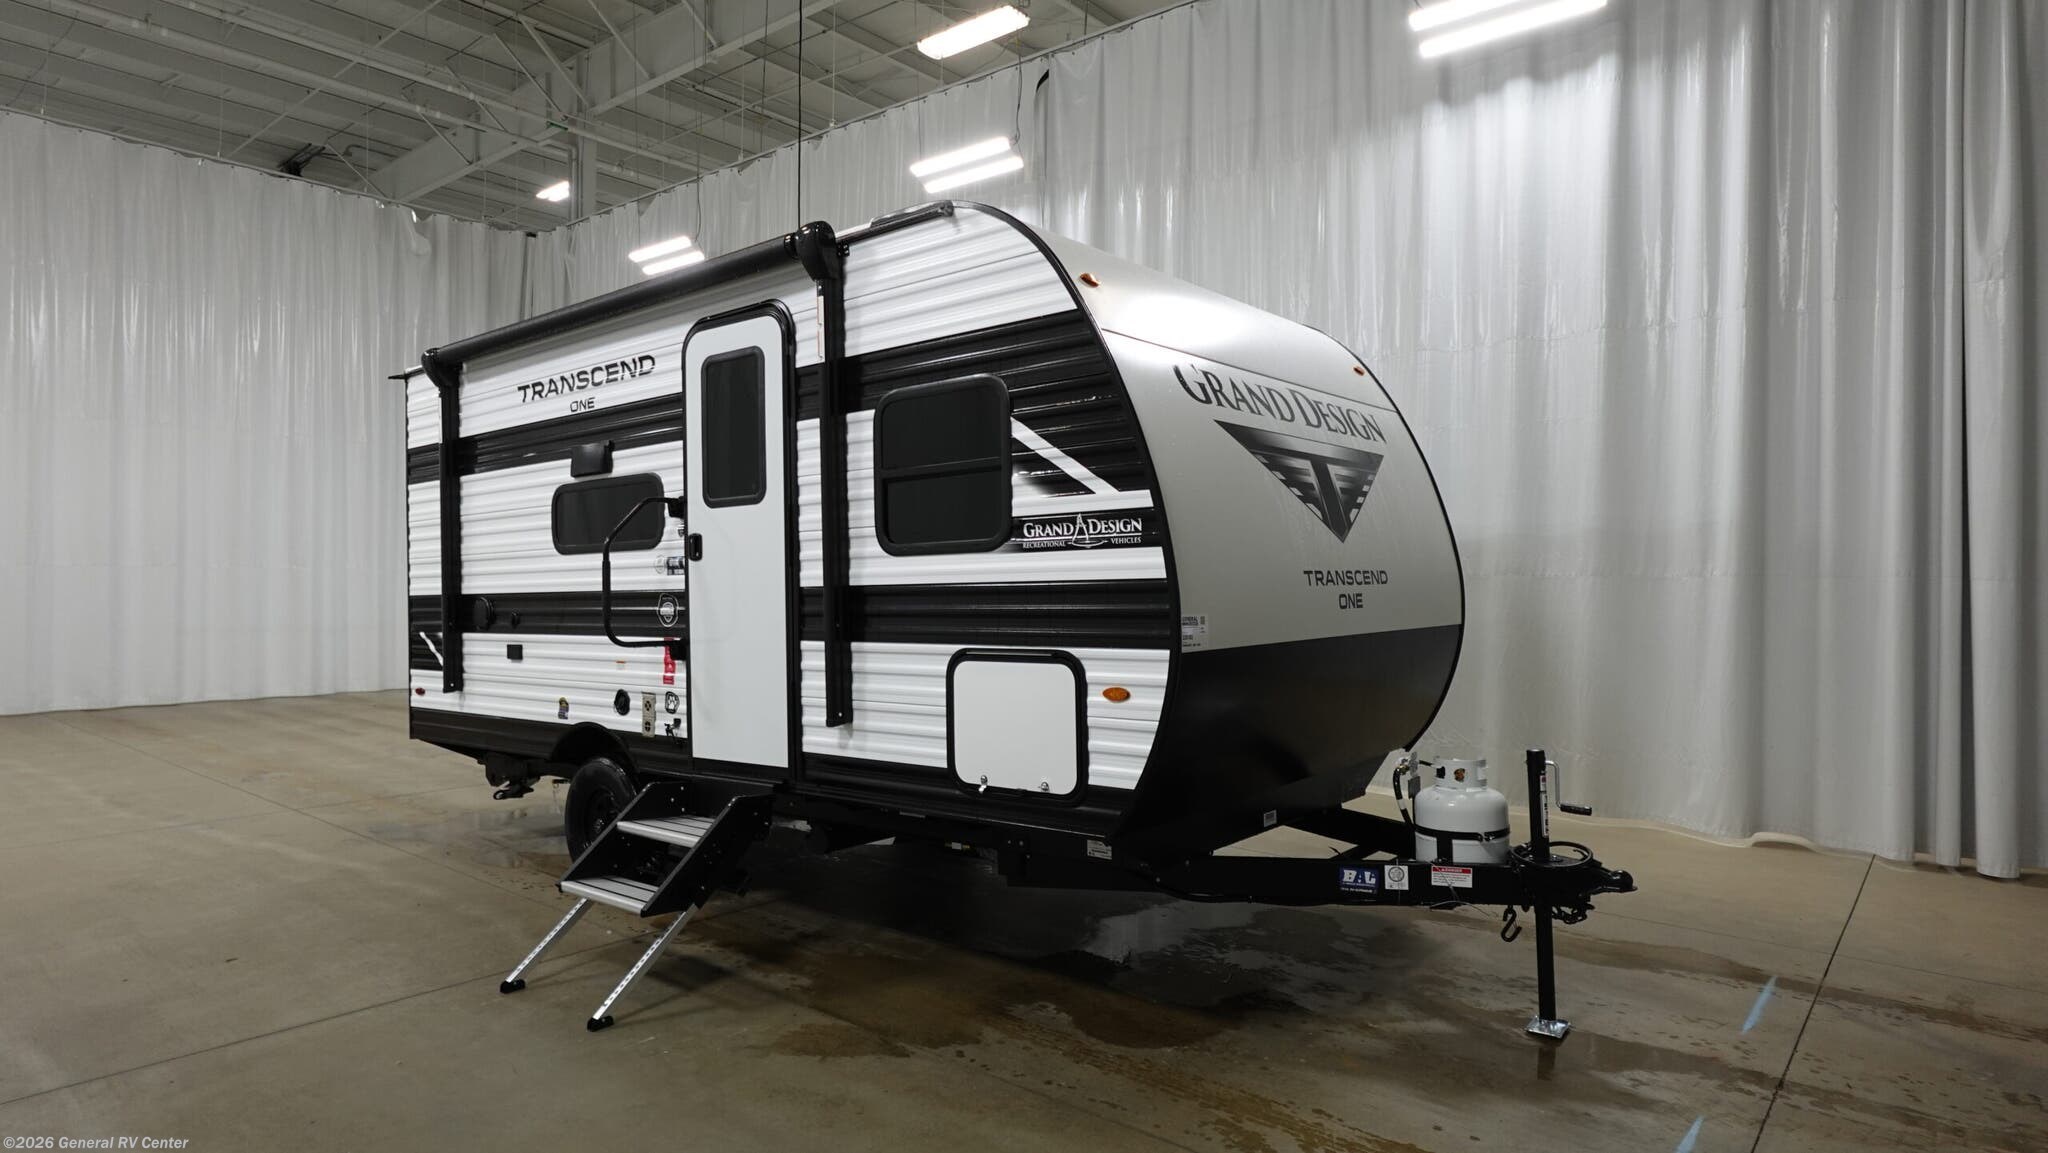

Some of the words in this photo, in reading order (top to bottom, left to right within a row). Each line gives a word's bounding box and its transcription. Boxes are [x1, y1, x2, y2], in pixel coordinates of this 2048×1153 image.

[517, 354, 656, 403] TRANSCEND
[569, 396, 597, 413] ONE
[1173, 363, 1296, 423] GRAND
[1286, 387, 1388, 444] DESIGN
[1023, 522, 1074, 538] GRAND
[1086, 518, 1143, 535] DESIGN
[1022, 540, 1067, 549] RECREATIONAL
[1110, 536, 1142, 545] VEHICLES
[1303, 569, 1389, 587] TRANSCEND
[1338, 592, 1364, 610] ONE
